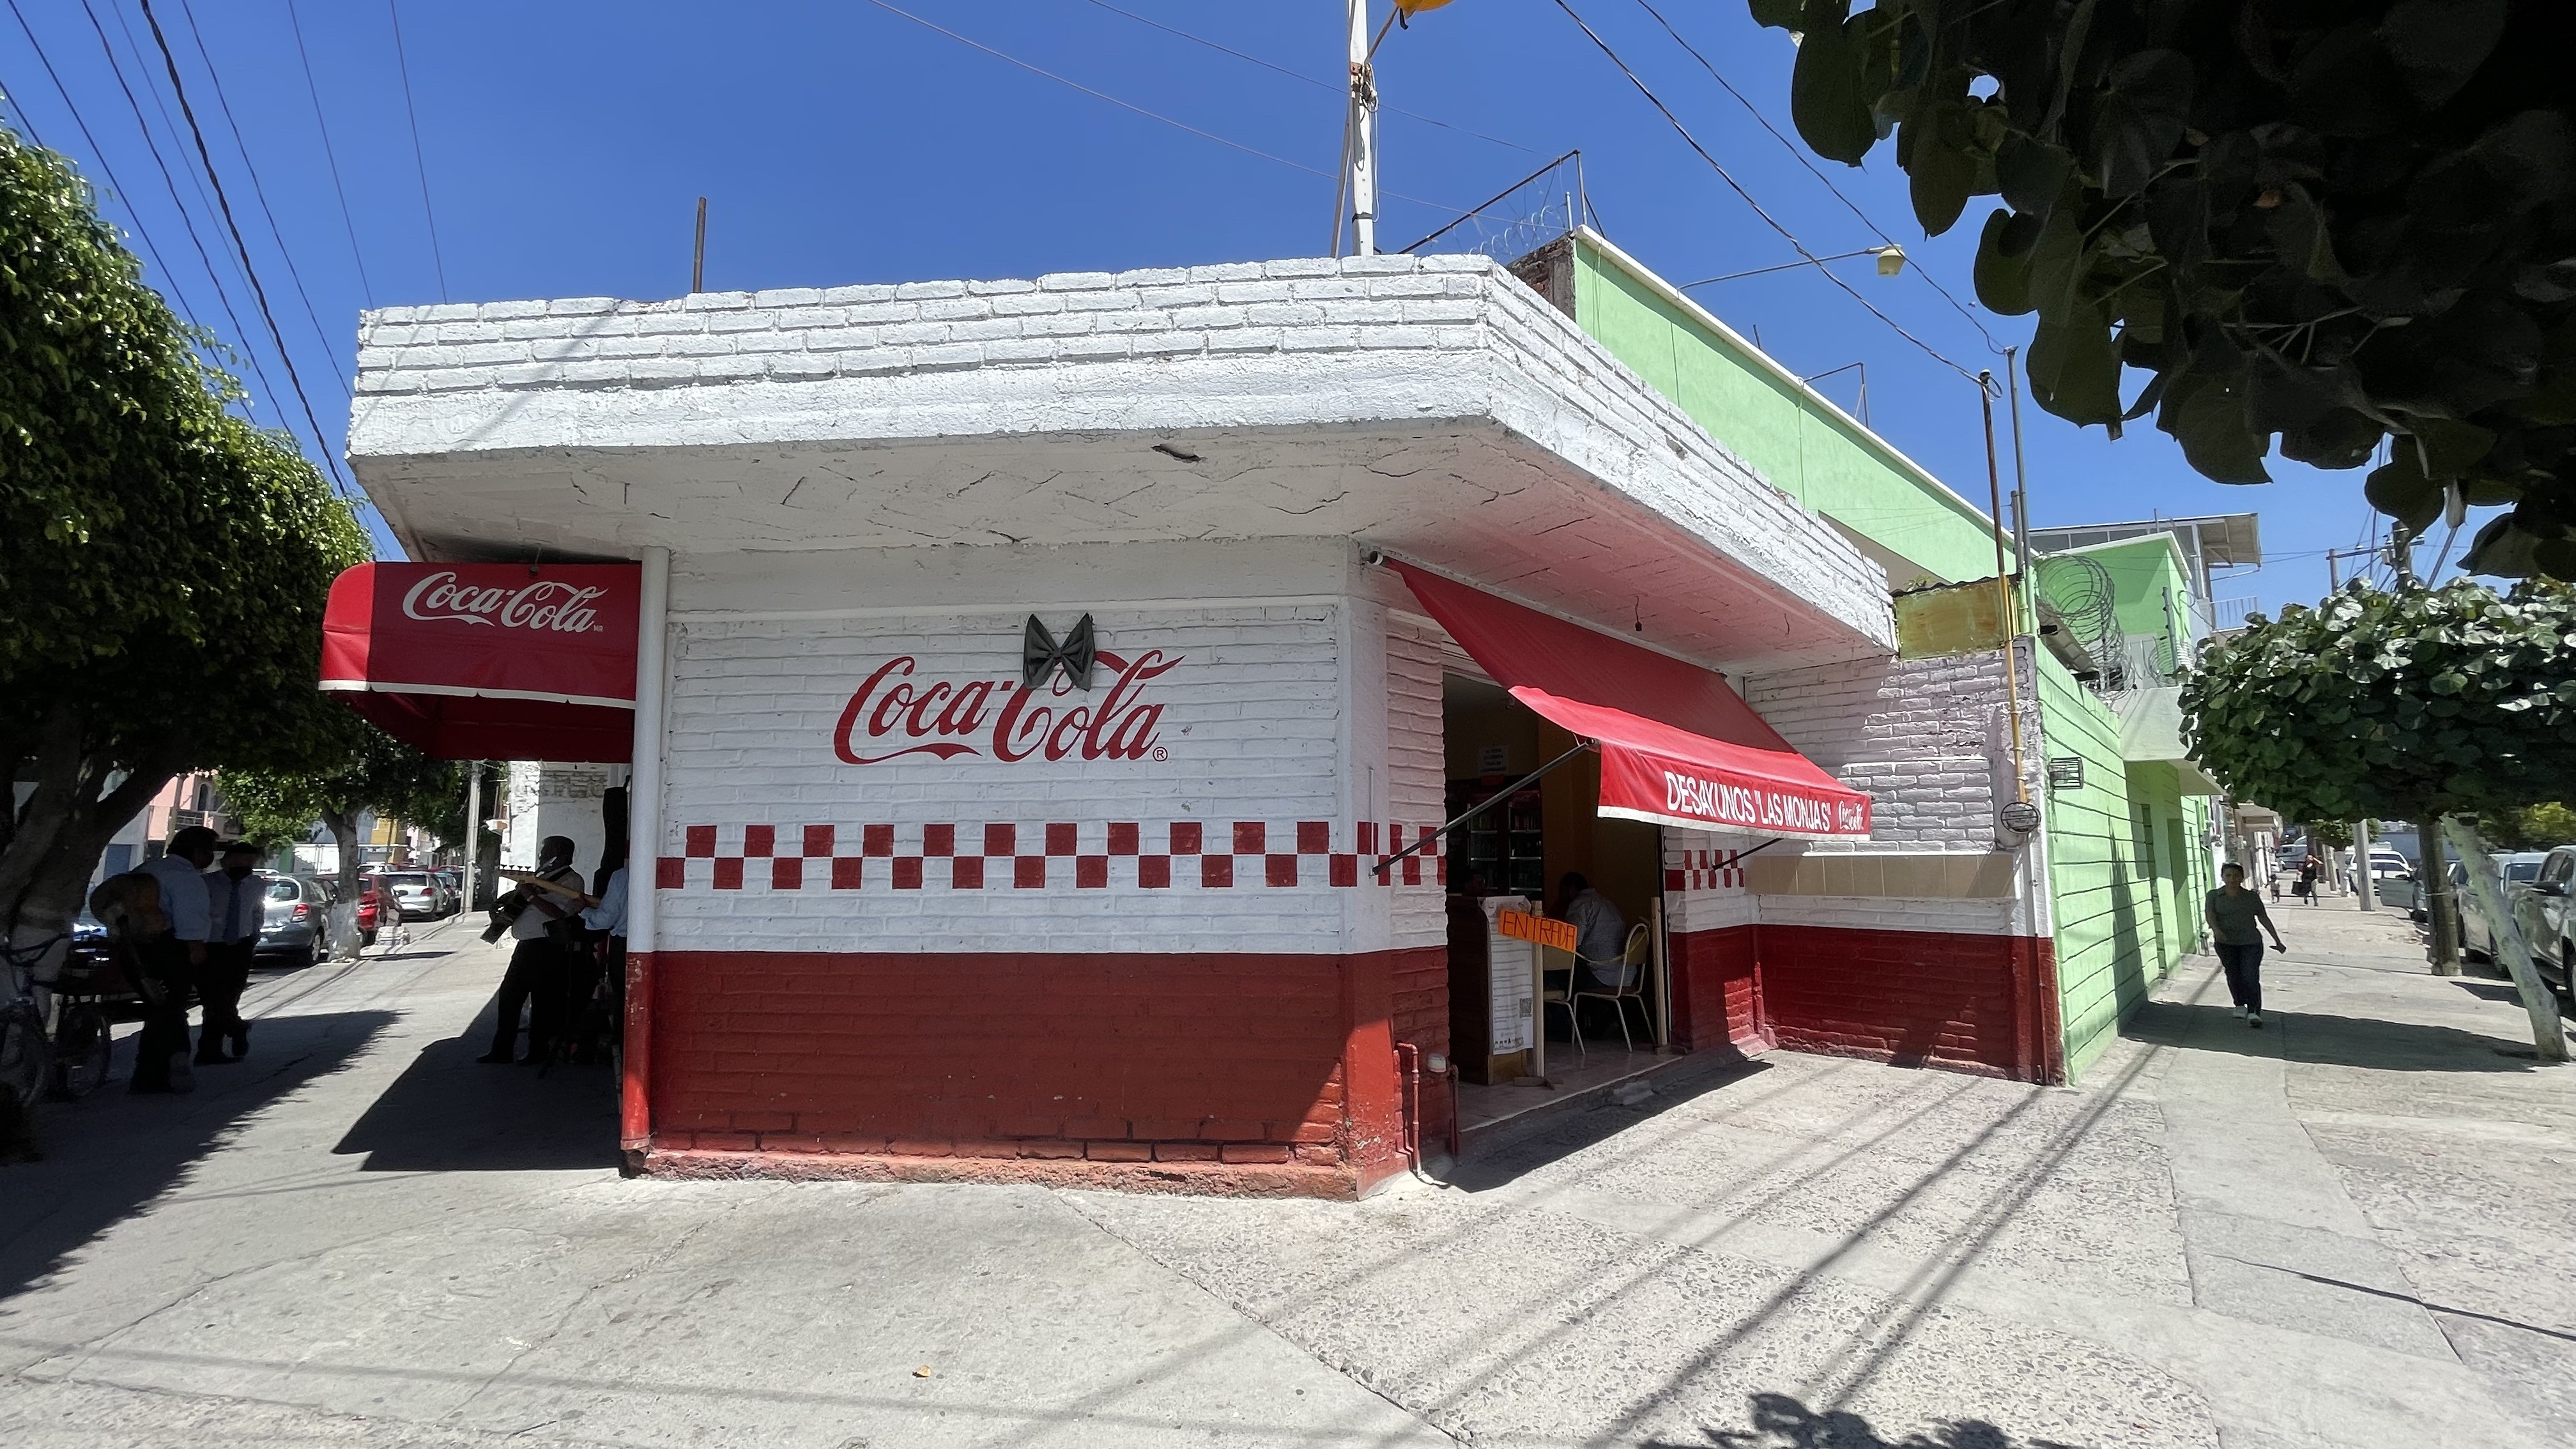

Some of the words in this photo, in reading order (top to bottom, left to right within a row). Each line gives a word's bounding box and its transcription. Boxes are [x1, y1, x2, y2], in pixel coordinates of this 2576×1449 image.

[402, 571, 608, 633] Coca-Cola
[834, 650, 1186, 765] Coca-Cola
[1664, 770, 1756, 824] DESAYUNOS
[1754, 790, 1784, 827] "LAS
[1782, 794, 1832, 832] MONJAS"
[1502, 910, 1575, 951] ENTRADA
